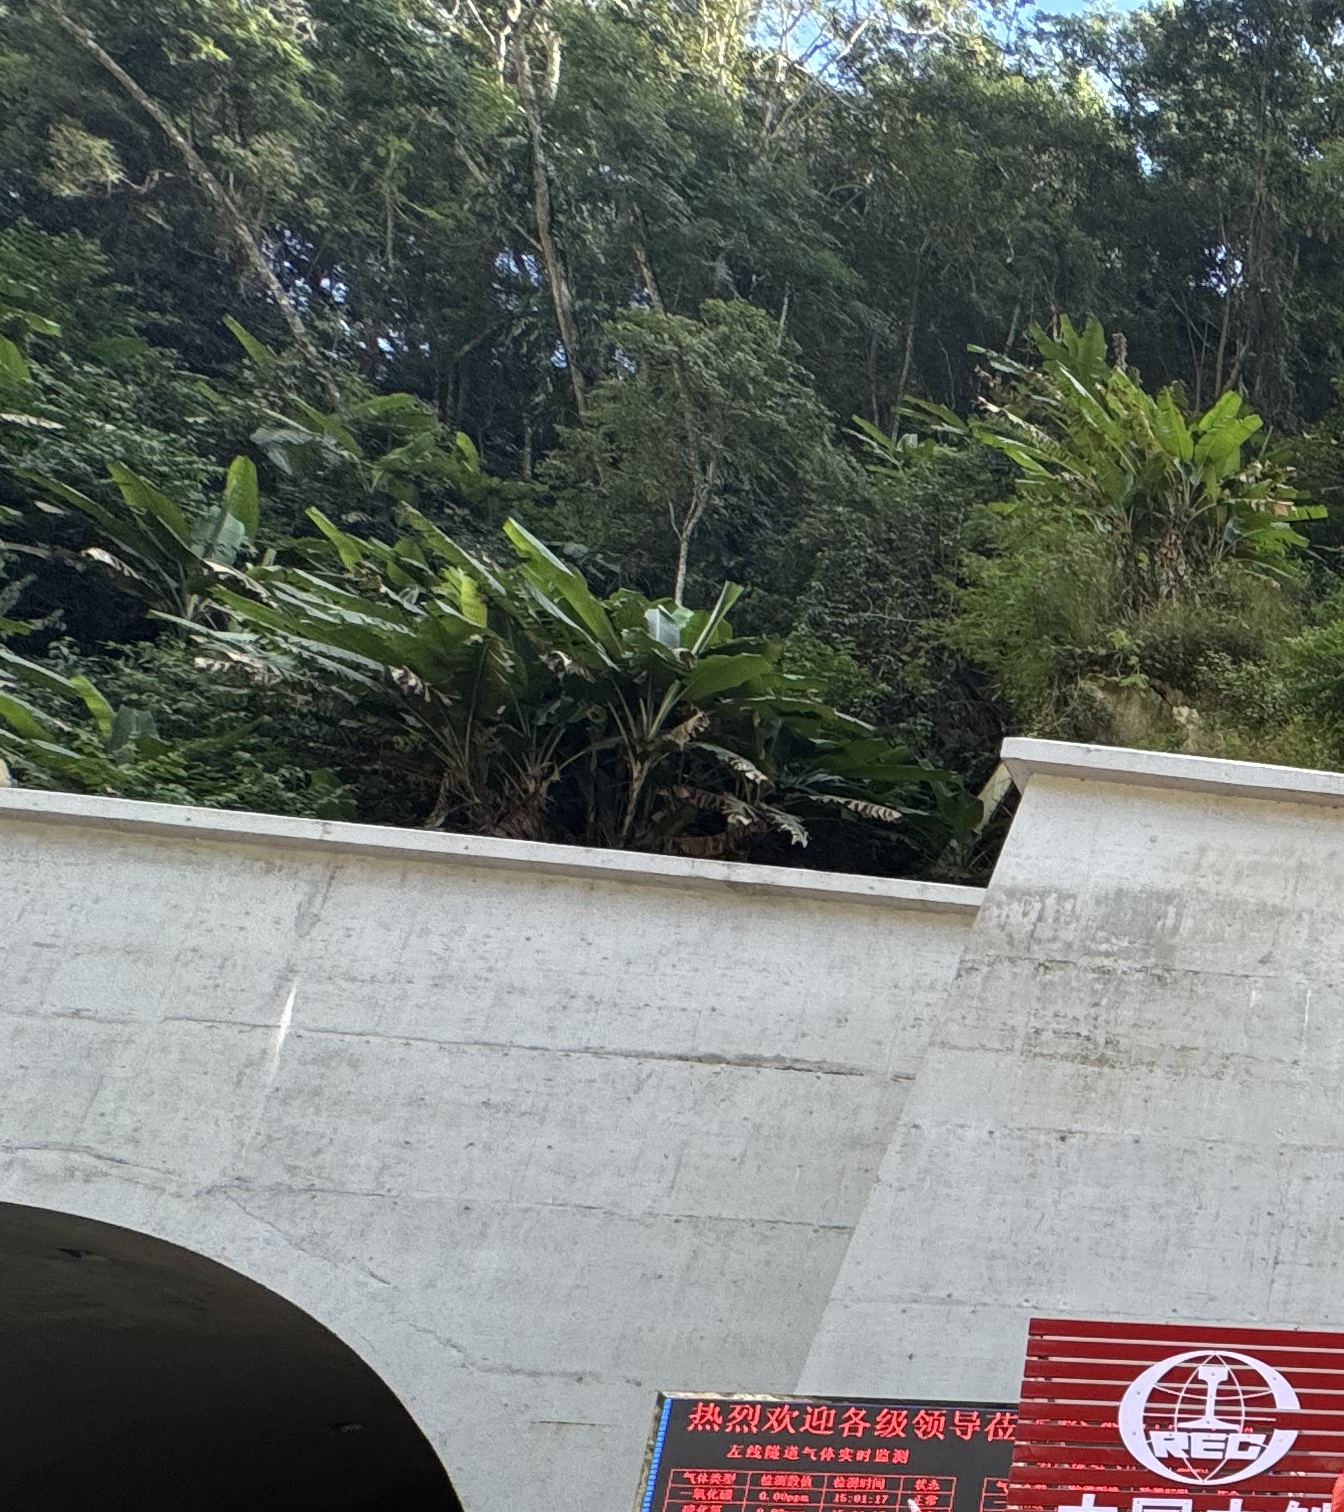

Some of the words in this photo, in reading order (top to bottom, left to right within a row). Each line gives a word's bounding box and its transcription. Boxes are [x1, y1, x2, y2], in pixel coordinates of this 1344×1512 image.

[686, 1402, 1016, 1441] 热烈欢迎各级领导莅
[726, 1445, 910, 1464] 左线隧道气体实时监测
